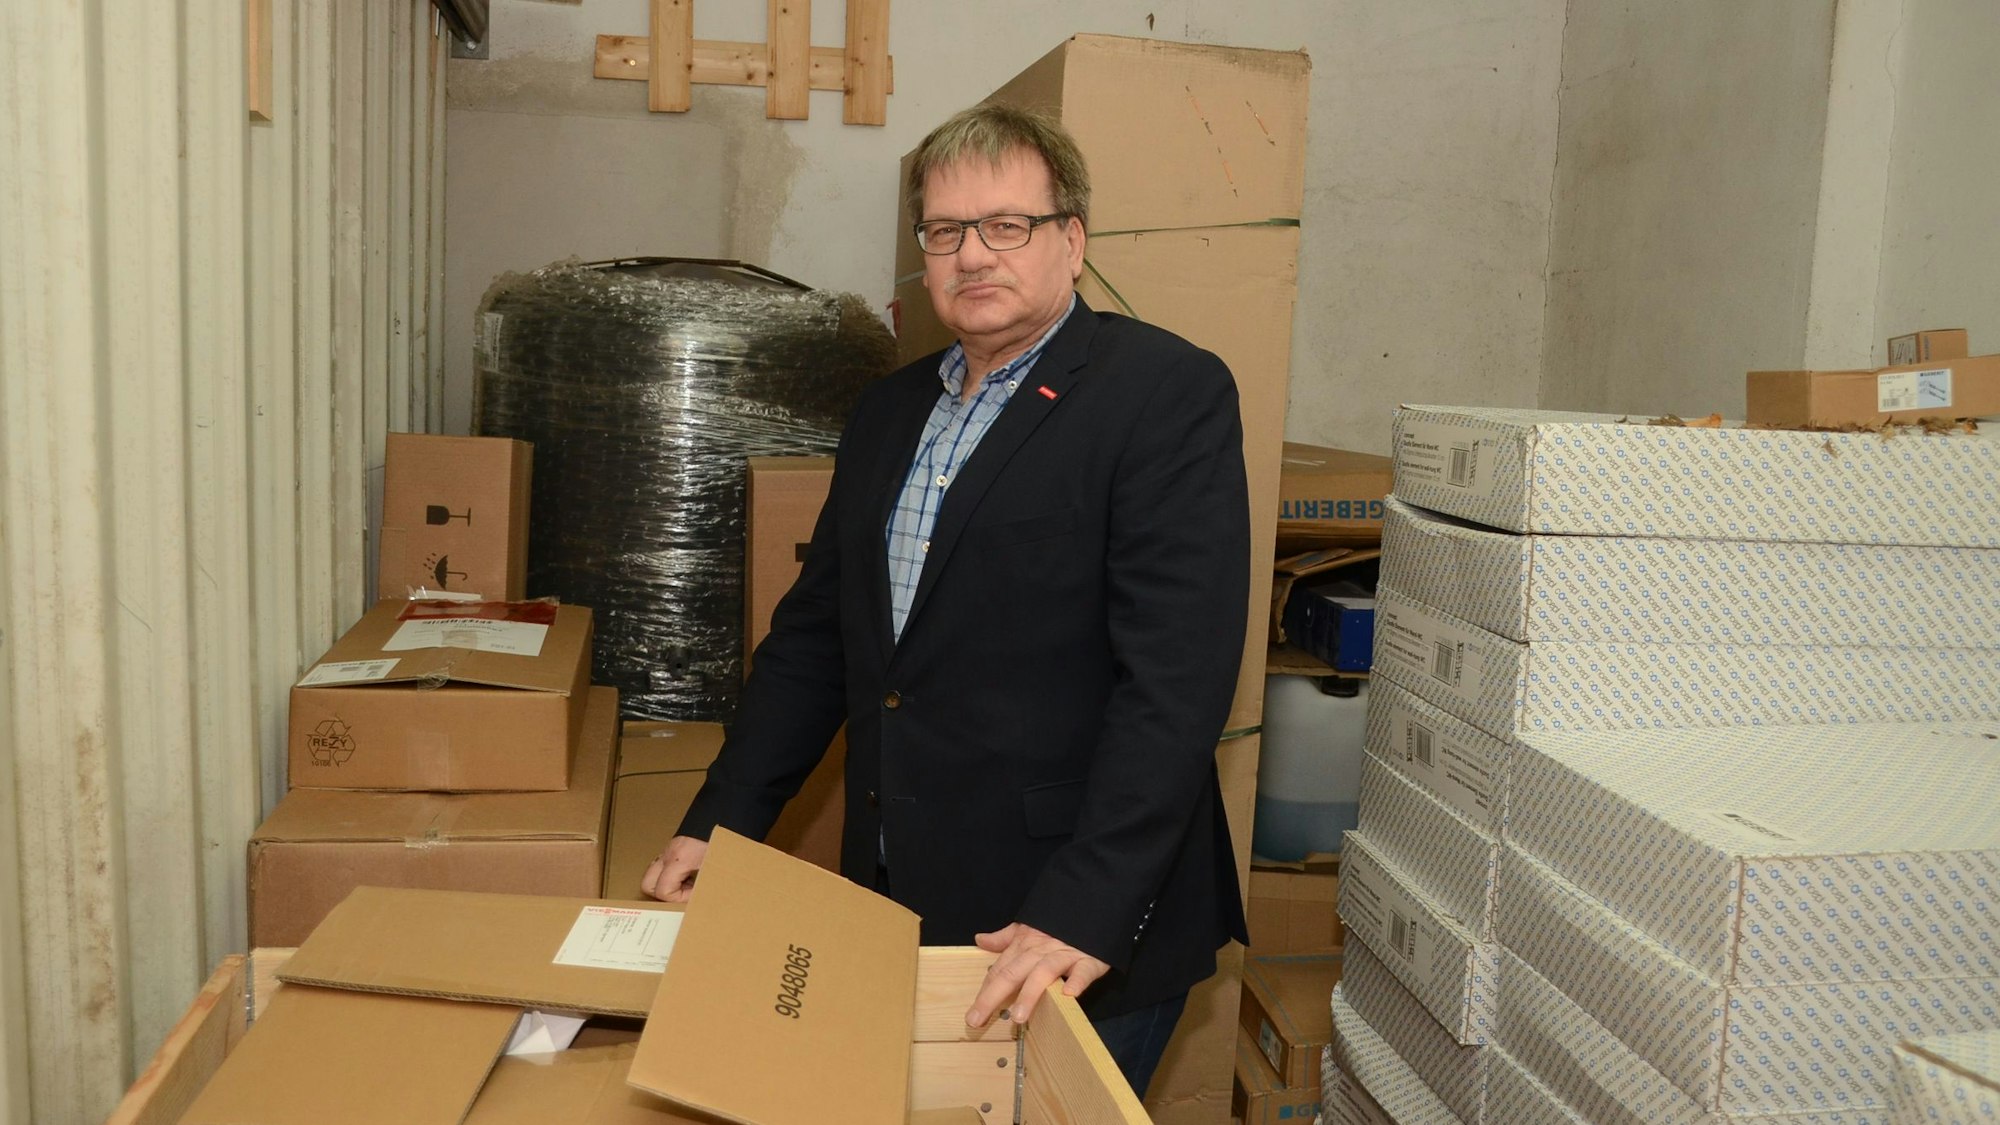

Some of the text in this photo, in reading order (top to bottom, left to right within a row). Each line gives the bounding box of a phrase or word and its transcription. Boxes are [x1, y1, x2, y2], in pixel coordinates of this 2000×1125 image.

[1280, 500, 1385, 519] GEBERIT
[313, 737, 347, 749] REZY
[775, 944, 812, 1019] 9048065
